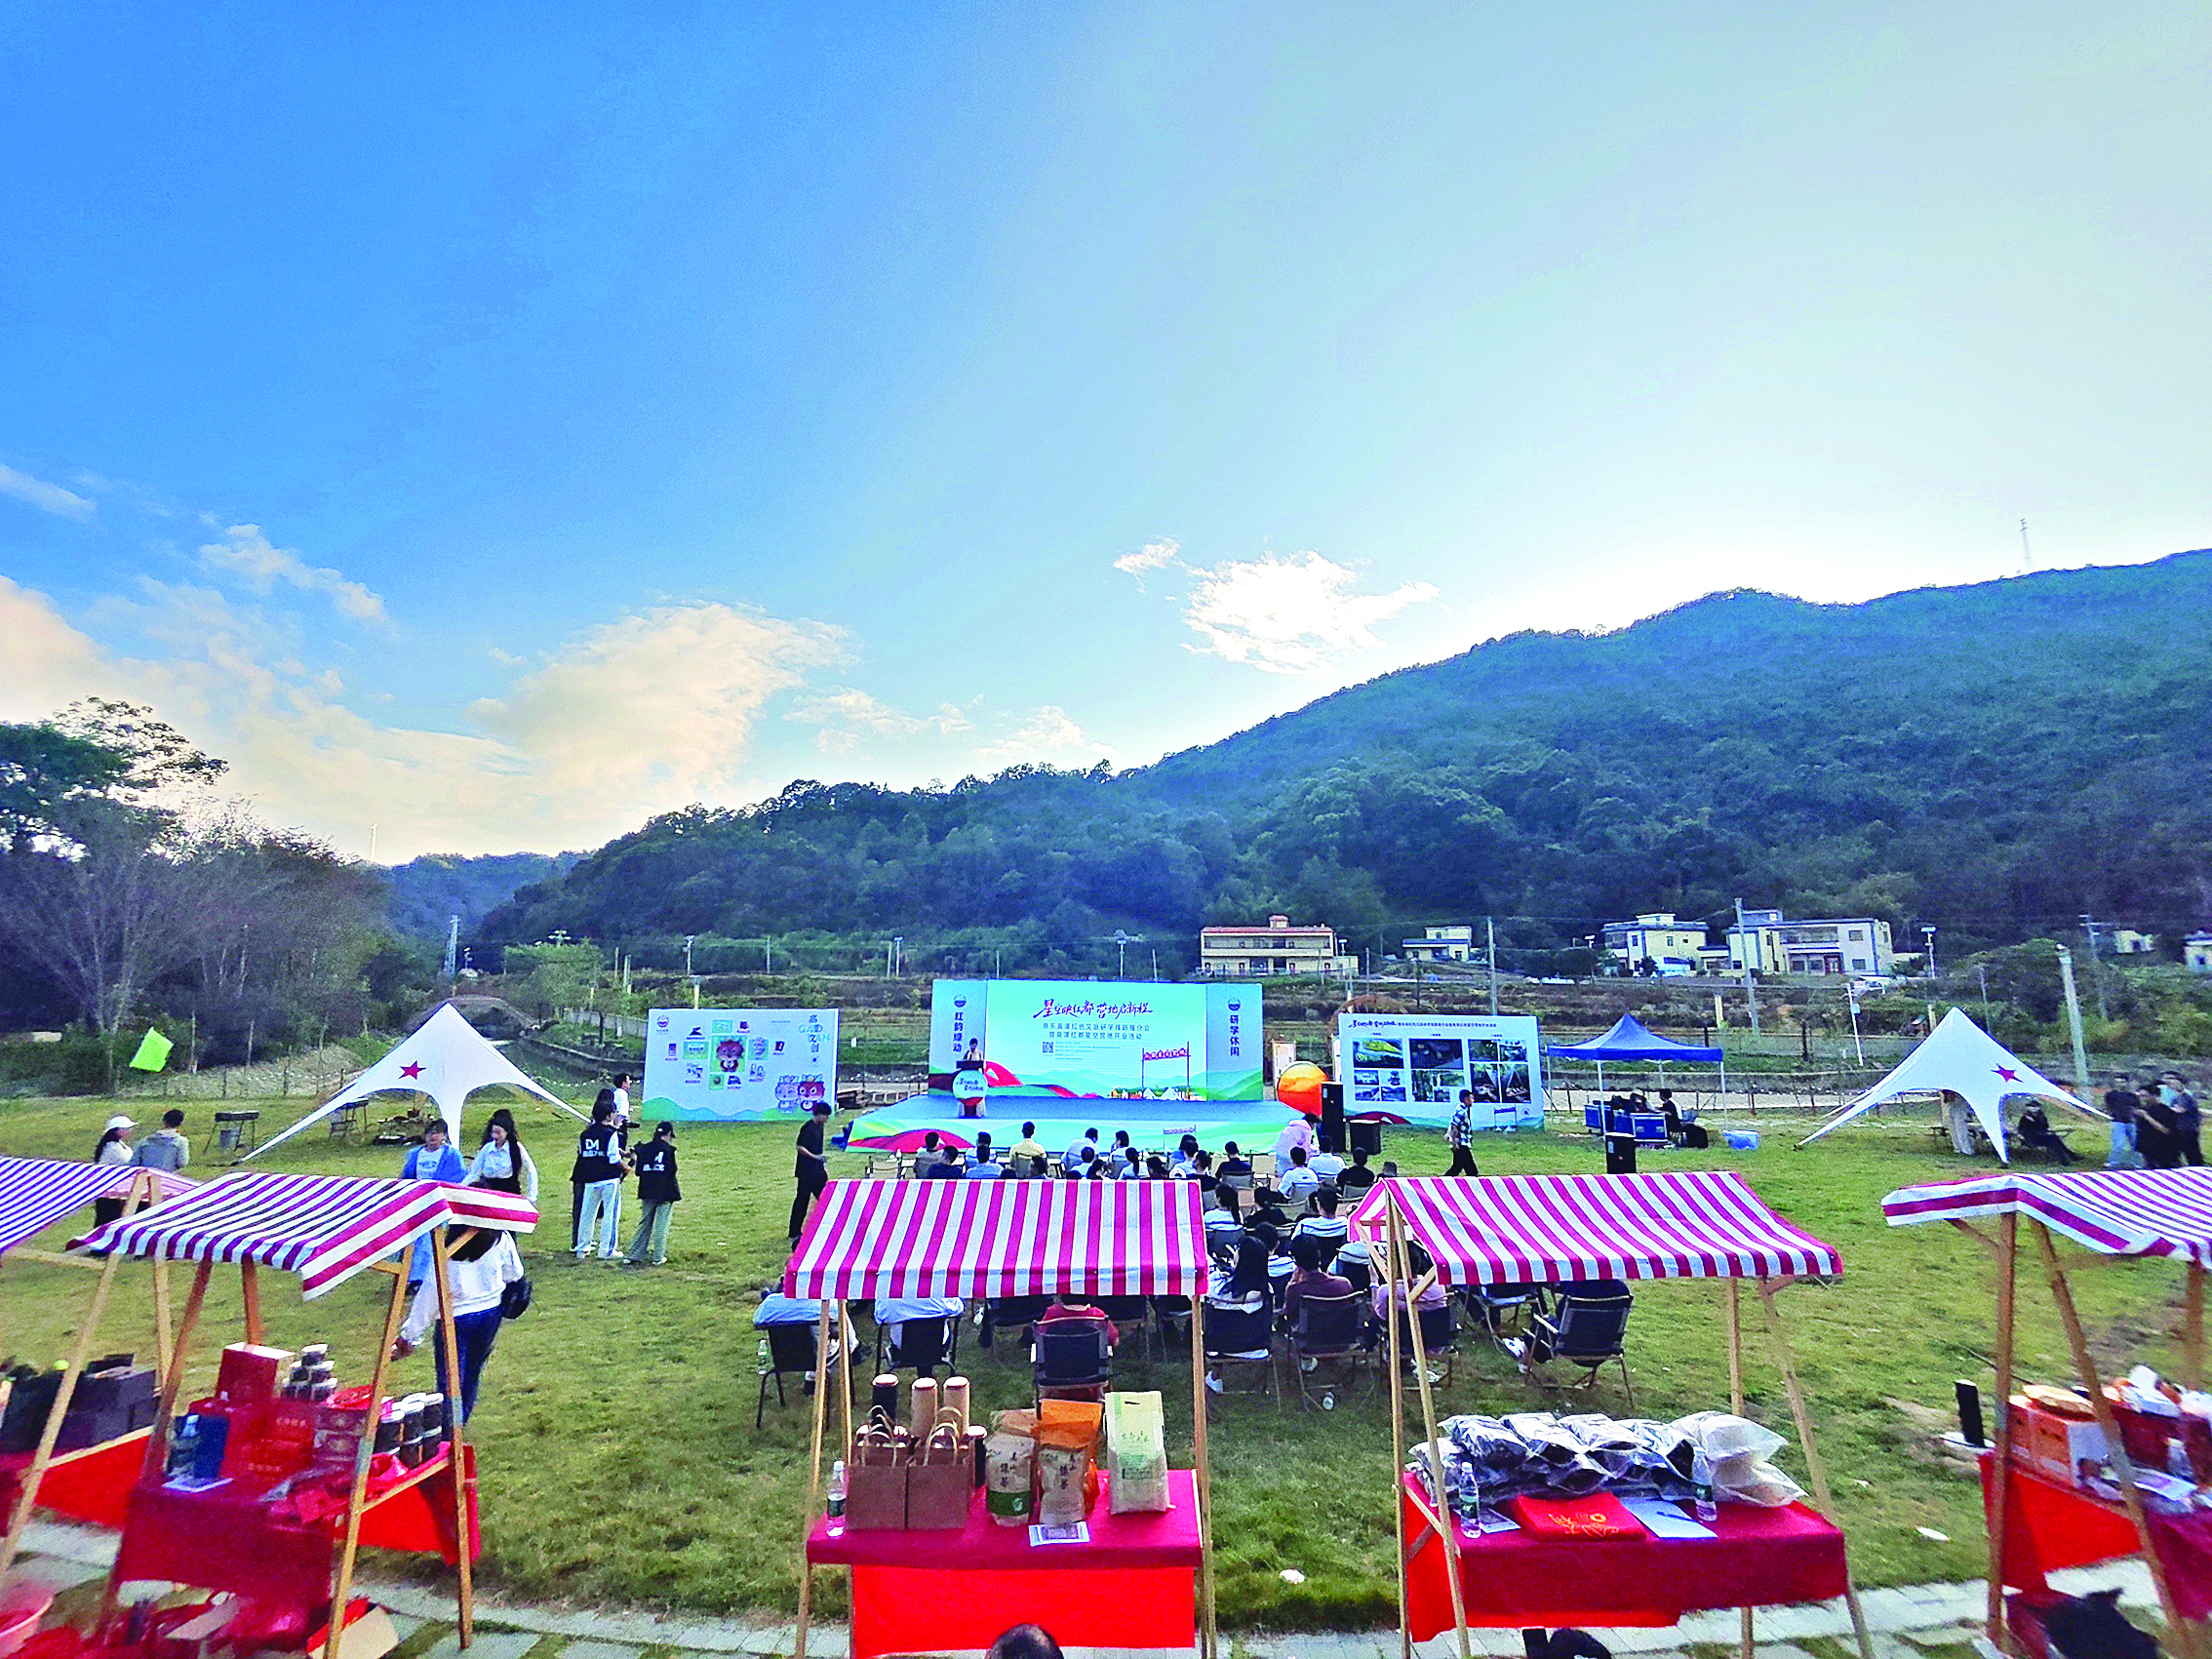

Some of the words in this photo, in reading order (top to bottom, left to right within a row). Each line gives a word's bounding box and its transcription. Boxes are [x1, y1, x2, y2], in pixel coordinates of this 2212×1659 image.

[1033, 999, 1094, 1019] 星空映红都
[1229, 1014, 1241, 1057] 研学休闲
